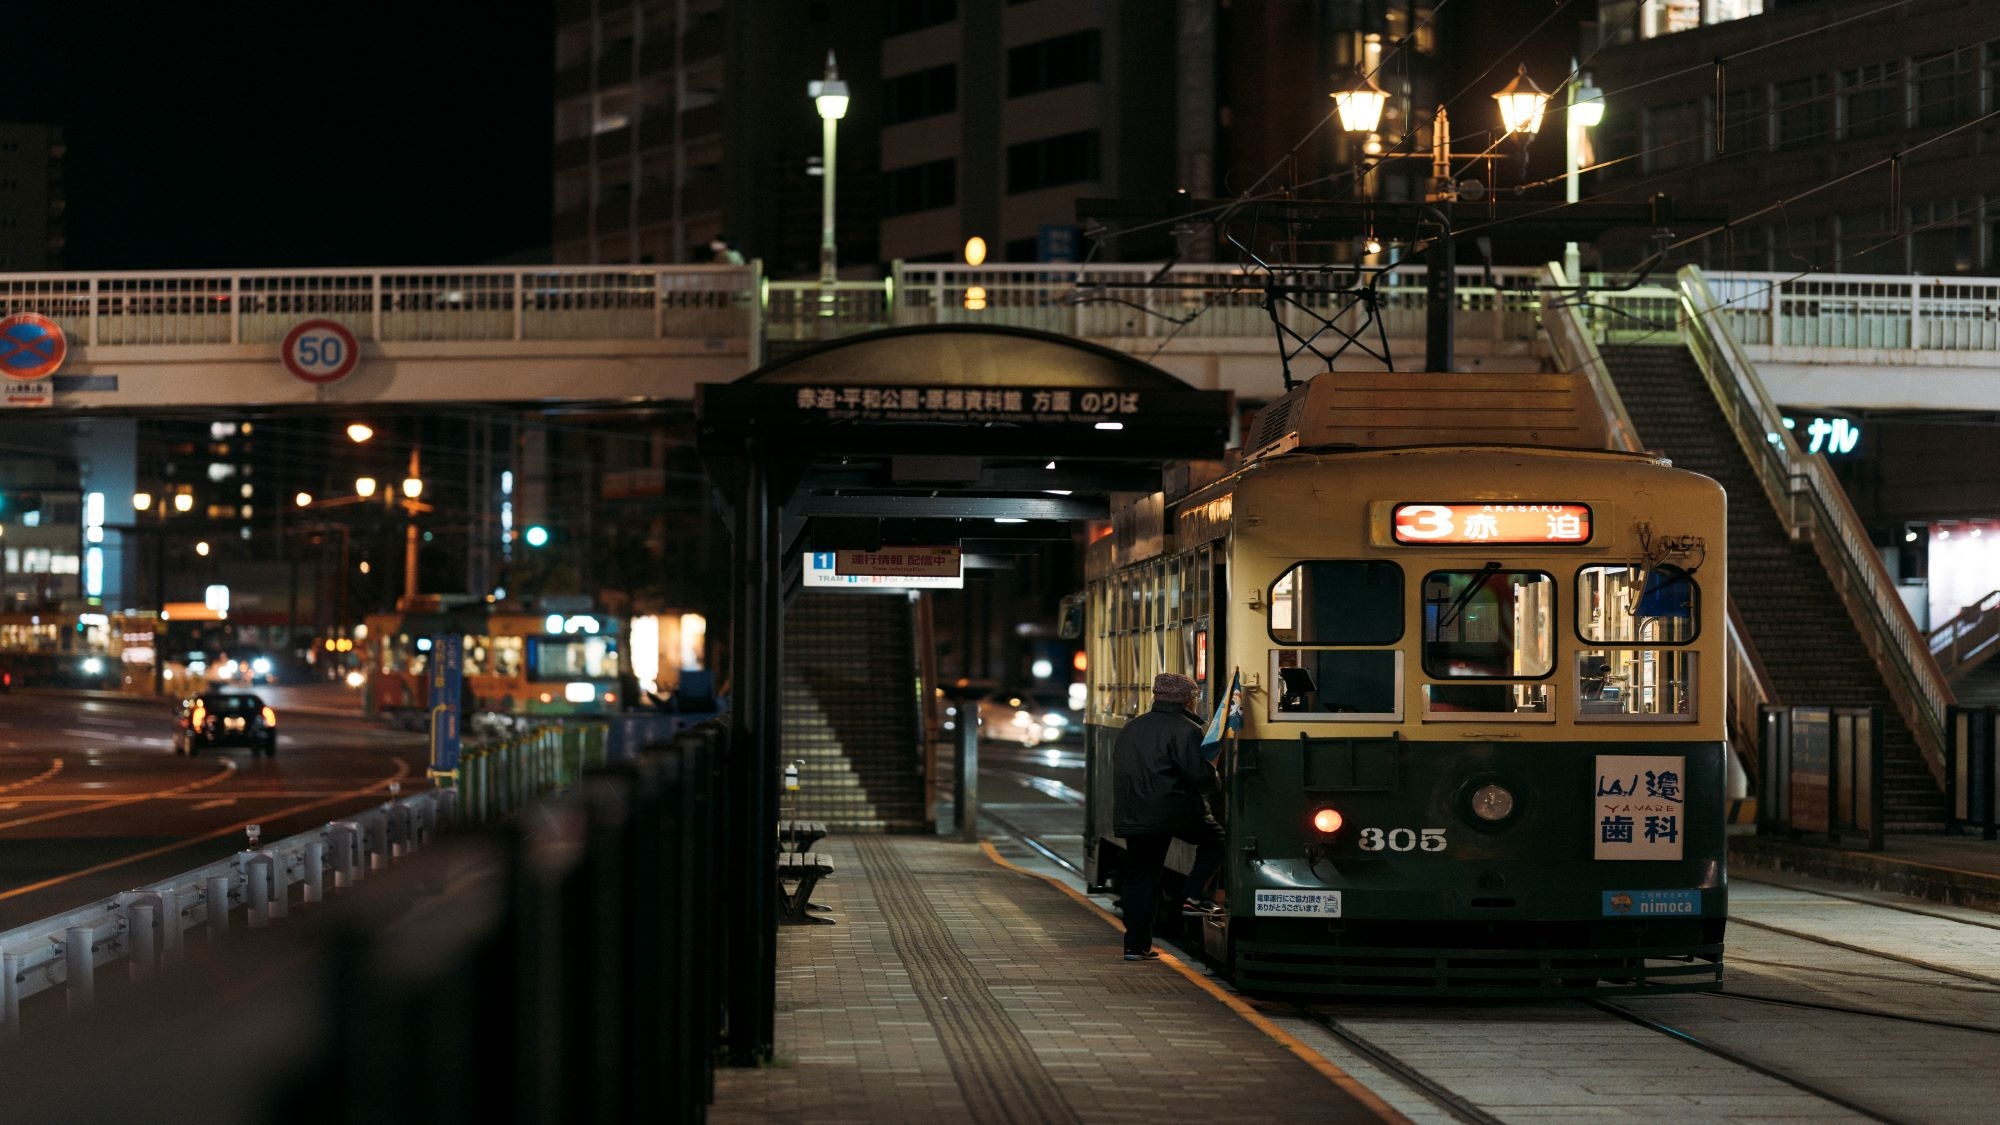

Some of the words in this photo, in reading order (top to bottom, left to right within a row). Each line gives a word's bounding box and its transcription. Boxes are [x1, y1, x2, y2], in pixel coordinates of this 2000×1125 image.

[299, 336, 342, 366] 50
[1032, 391, 1071, 413] 方面
[1080, 392, 1140, 414] のりば
[1396, 505, 1454, 538] 3
[852, 554, 903, 566] 運行情報
[907, 555, 945, 566] 配信中
[1358, 827, 1448, 852] 305
[1601, 815, 1678, 843] 歯科
[1640, 899, 1692, 913] nimoca
